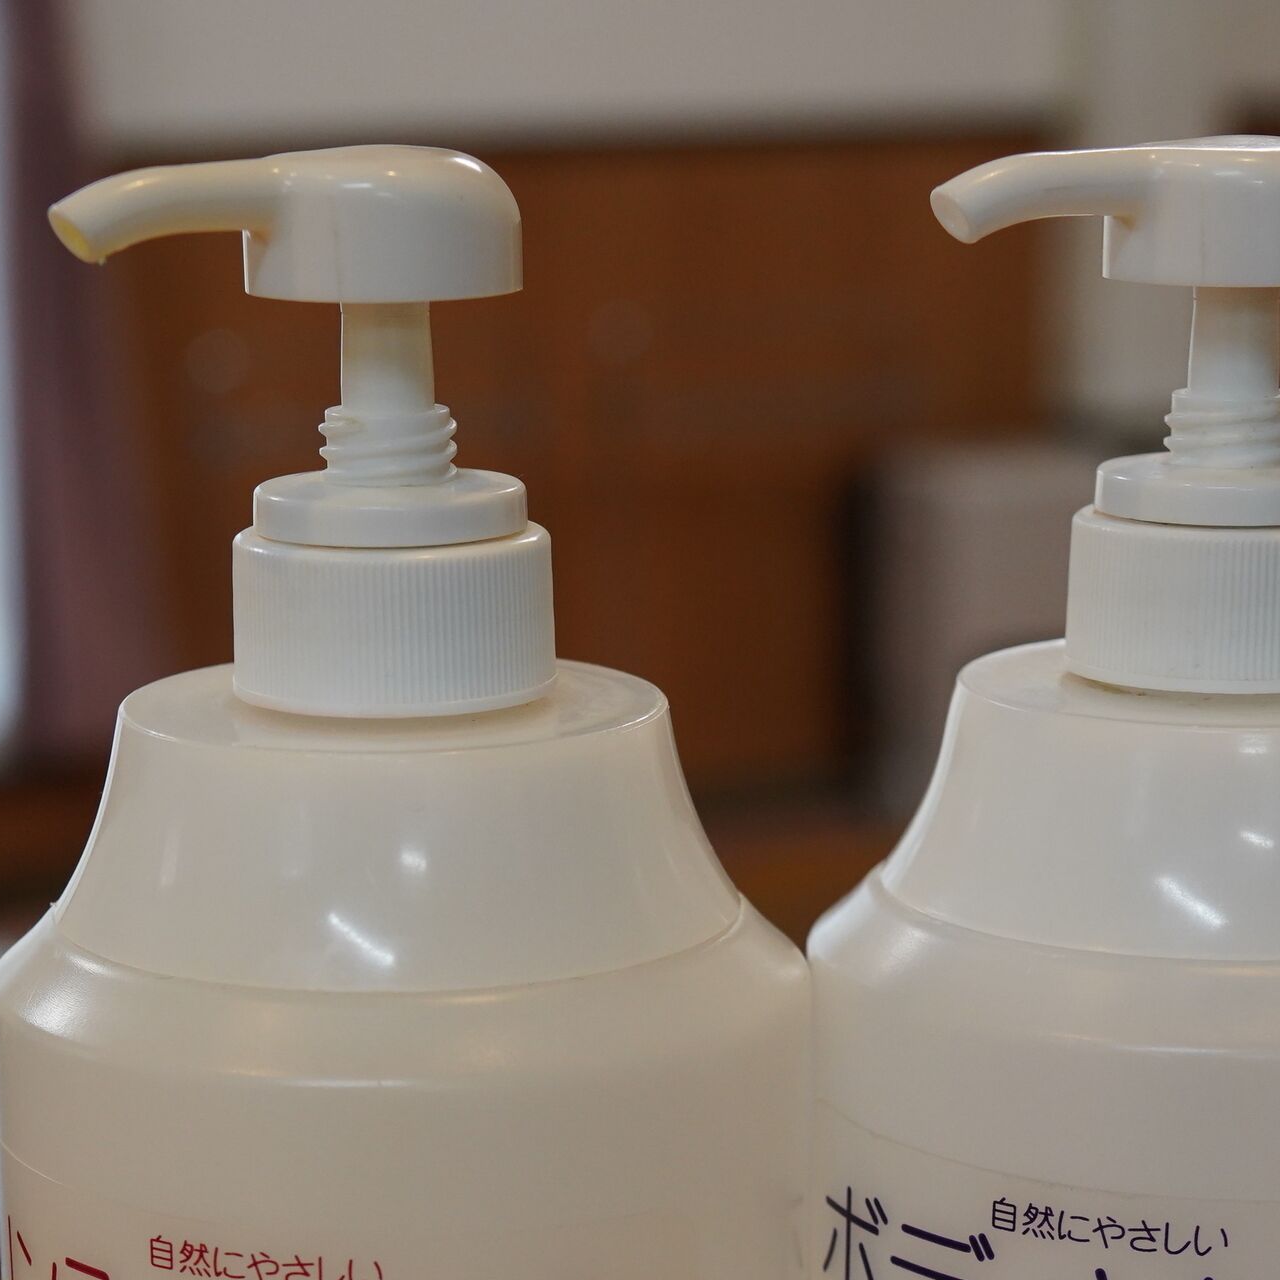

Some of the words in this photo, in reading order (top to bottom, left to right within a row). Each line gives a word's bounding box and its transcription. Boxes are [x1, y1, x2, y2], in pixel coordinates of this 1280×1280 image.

[991, 1198, 1229, 1257] 自然にやさしい
